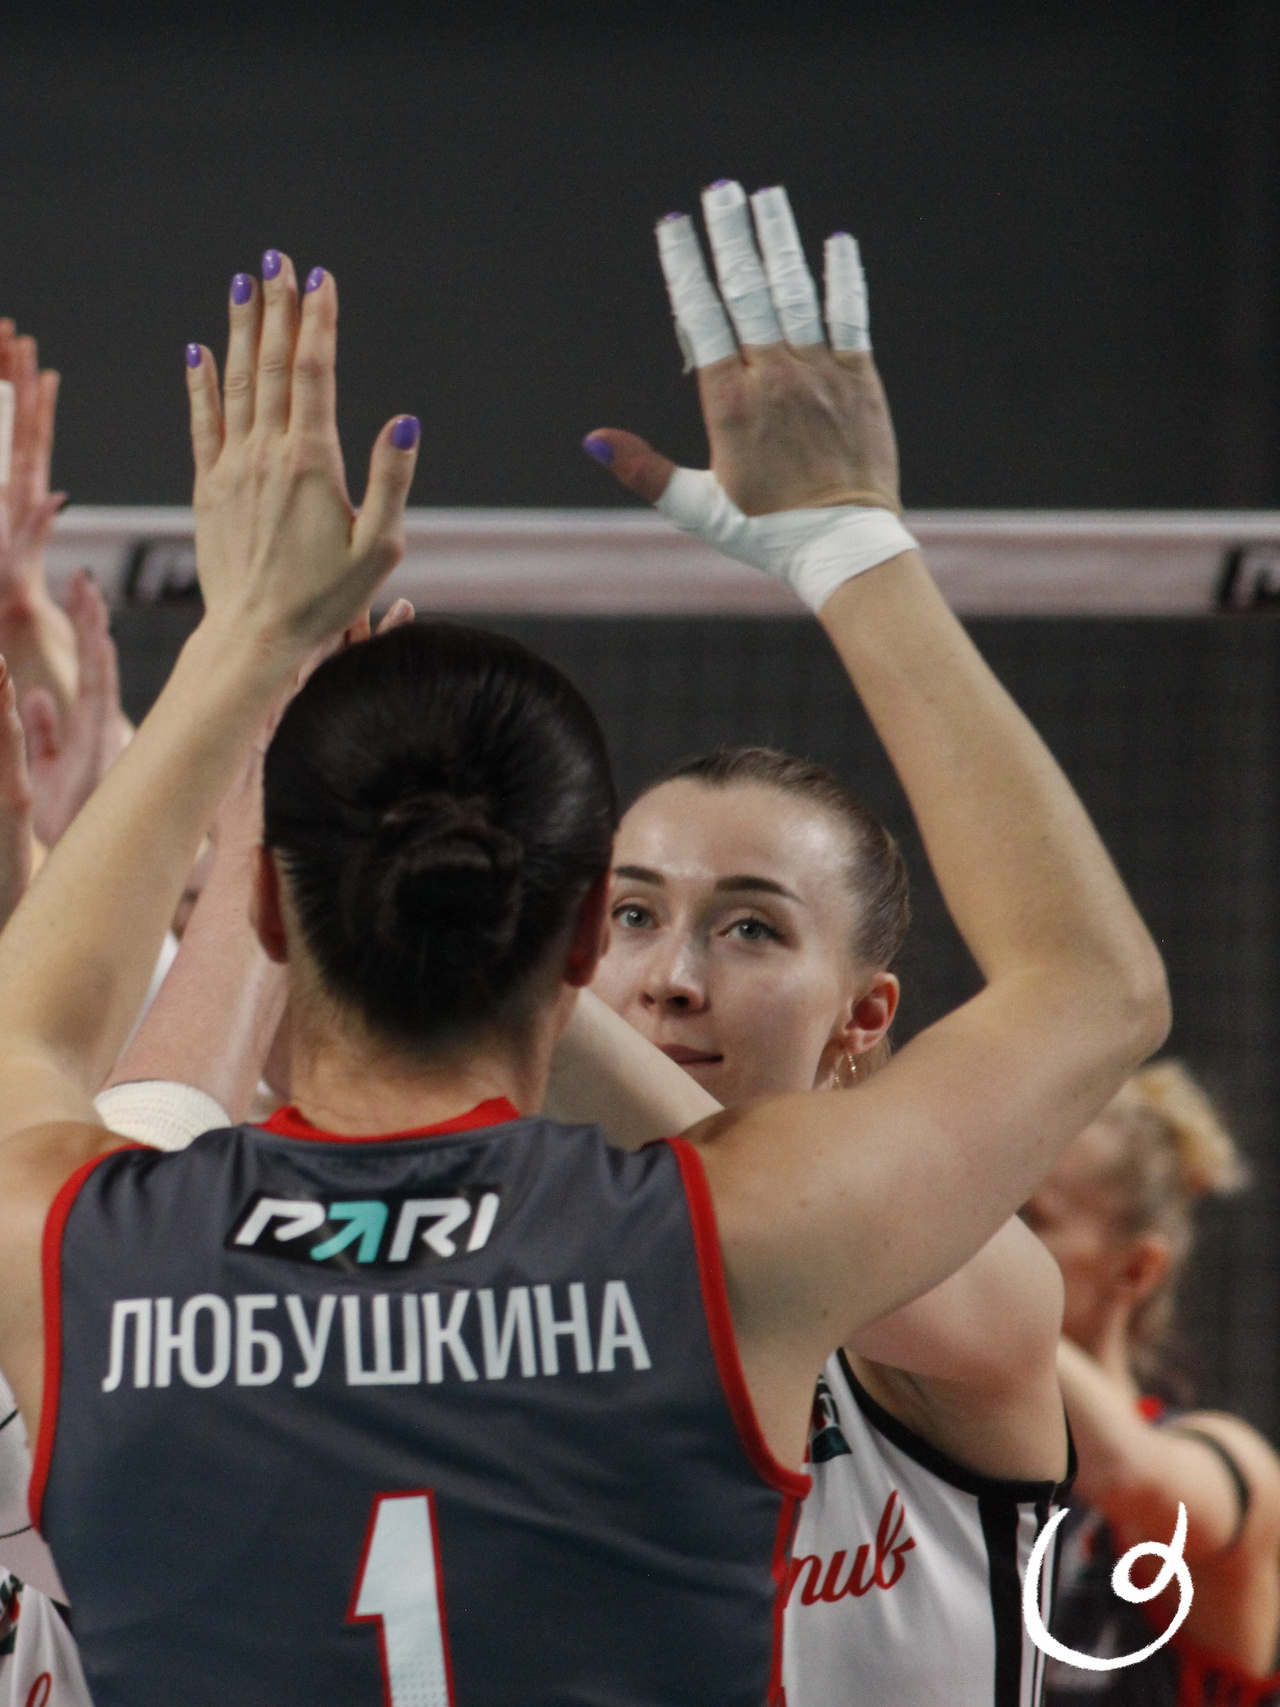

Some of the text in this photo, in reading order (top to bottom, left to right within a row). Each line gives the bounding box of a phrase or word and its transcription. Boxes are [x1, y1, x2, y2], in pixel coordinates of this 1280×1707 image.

[235, 1192, 500, 1263] PARI
[102, 1280, 651, 1392] ЛЮБУШКИНА
[345, 1487, 456, 1707] 1
